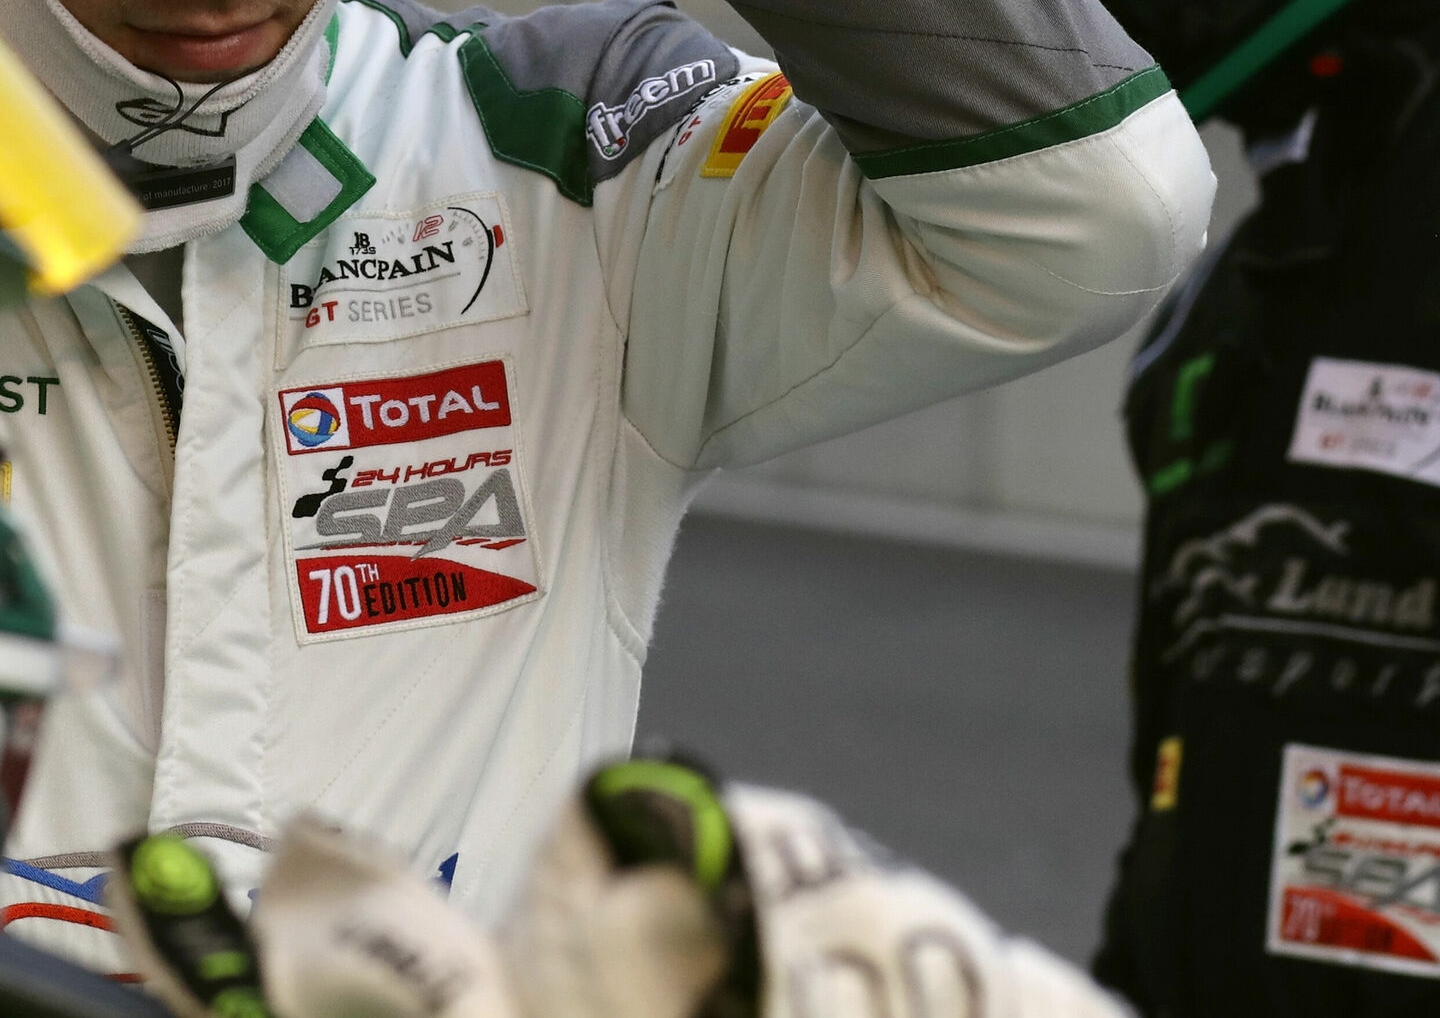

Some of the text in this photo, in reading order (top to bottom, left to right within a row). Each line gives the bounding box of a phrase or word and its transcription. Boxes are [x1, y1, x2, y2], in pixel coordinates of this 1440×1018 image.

[588, 59, 712, 152] freem
[154, 183, 208, 199] manufacture
[212, 177, 231, 189] 2017
[290, 241, 456, 308] BANCPAIN
[305, 293, 432, 328] GT SERIES
[350, 387, 500, 429] TOTAL
[352, 449, 513, 488] 24 HOURS
[316, 467, 528, 561] SPA
[364, 571, 467, 618] EDITION
